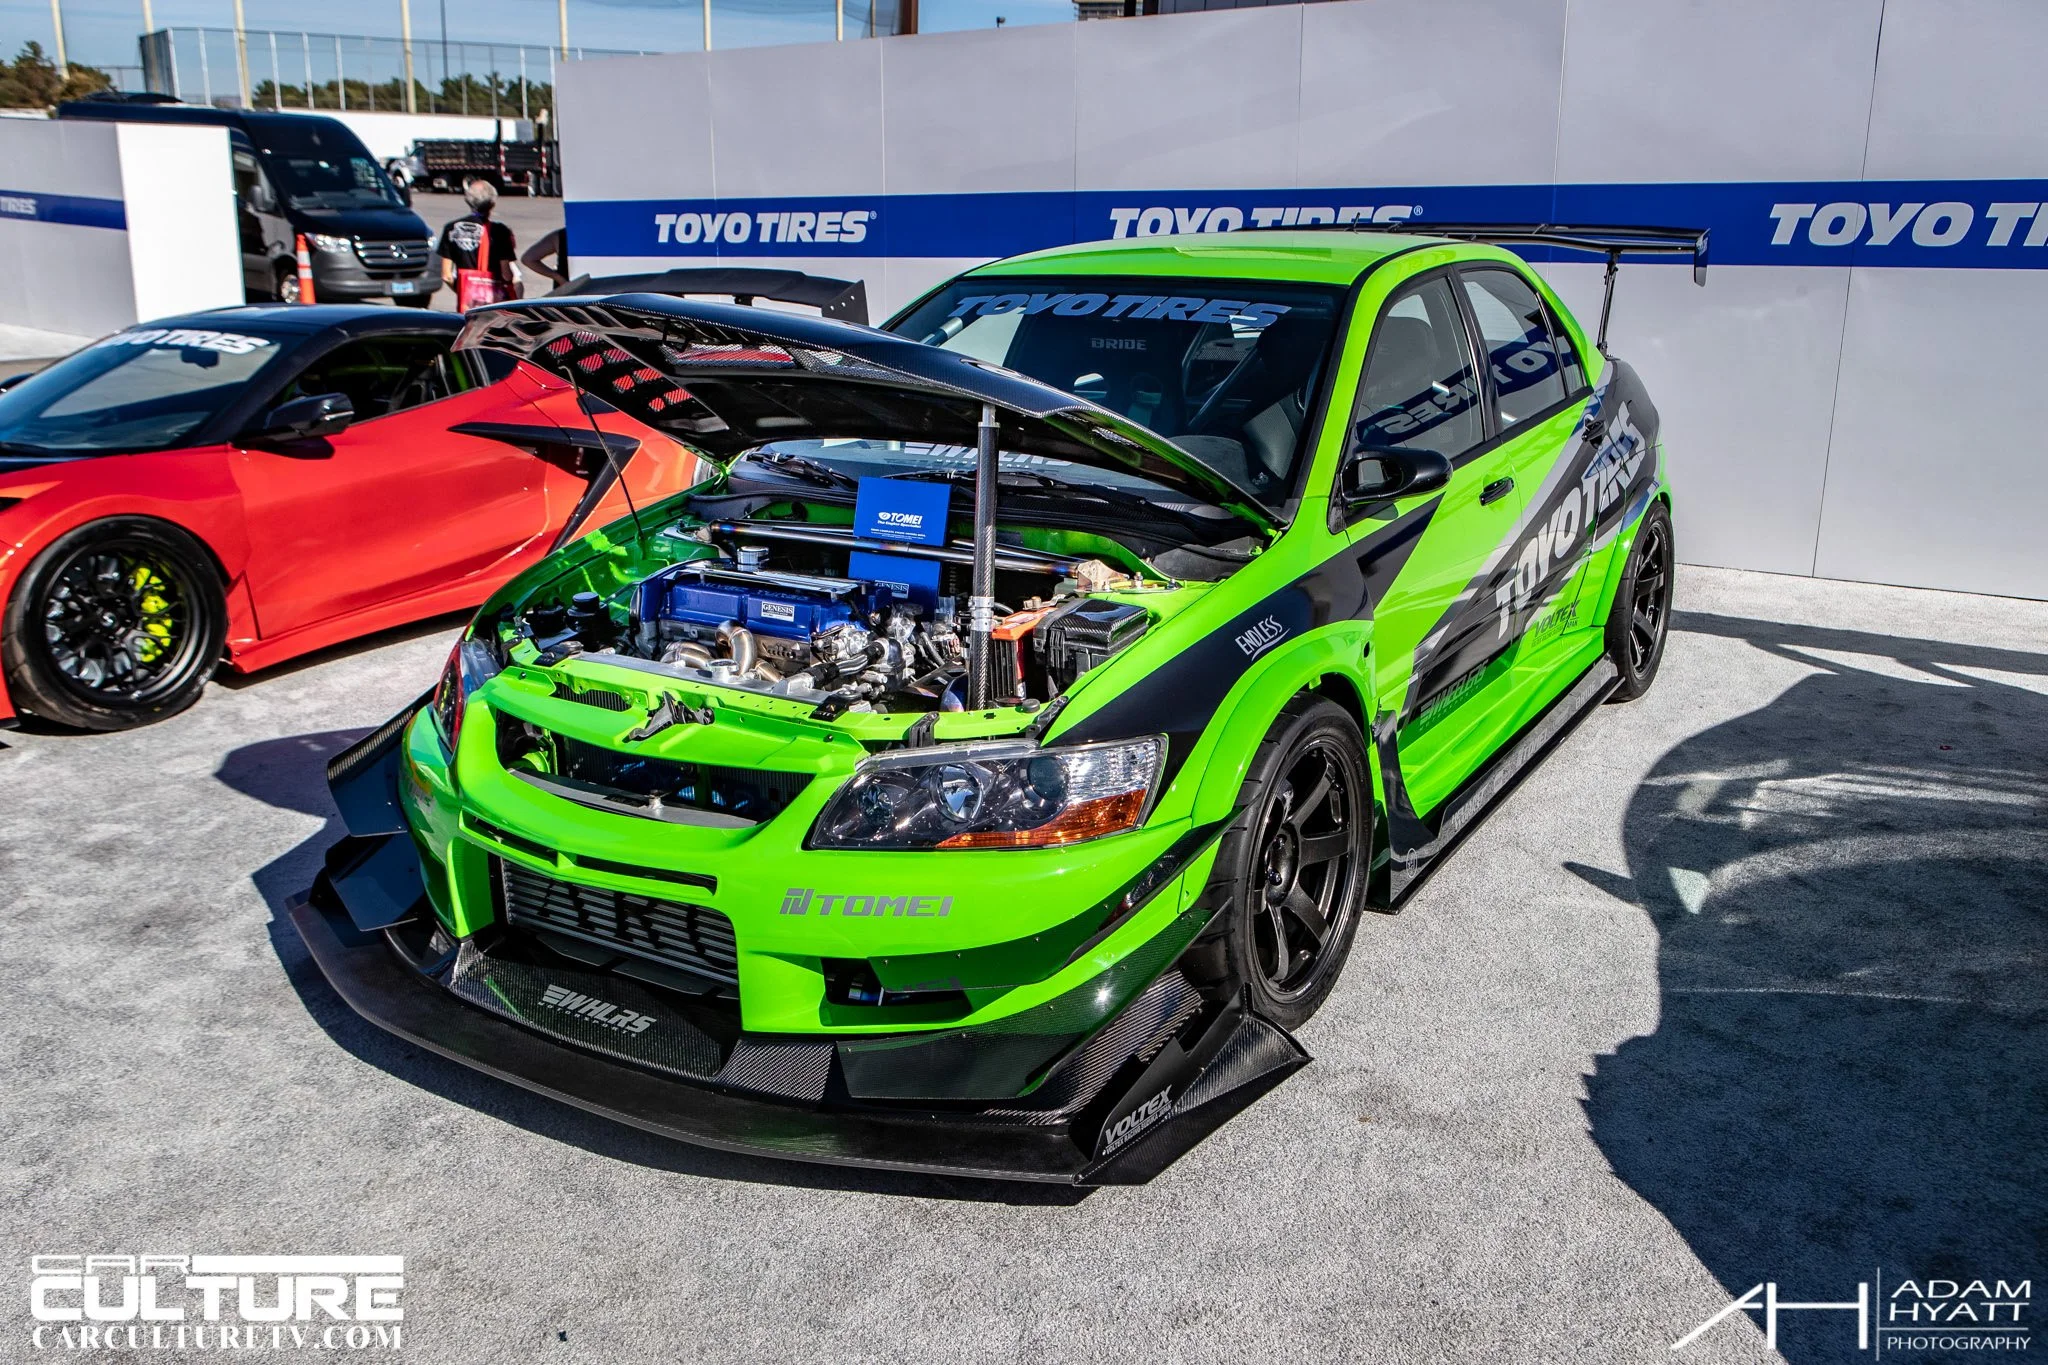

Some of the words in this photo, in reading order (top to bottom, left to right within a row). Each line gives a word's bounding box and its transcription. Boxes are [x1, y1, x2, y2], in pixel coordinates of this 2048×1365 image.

[655, 212, 752, 243] TOYO
[1110, 206, 1244, 239] TOYO
[1769, 202, 1975, 247] TOYO
[947, 293, 1110, 317] TOYO
[1102, 294, 1293, 329] TIRES
[154, 329, 271, 354] TIRES
[1090, 337, 1147, 351] BRIDE
[890, 512, 923, 525] TOMEI
[1495, 487, 1582, 640] TOYO
[1581, 401, 1647, 529] TIRES
[762, 602, 794, 614] GENESIS
[1534, 600, 1581, 638] VOLTEX
[1234, 614, 1283, 656] ENDLESS
[815, 894, 955, 918] TOMEI
[1105, 1084, 1173, 1145] VOLTEX
